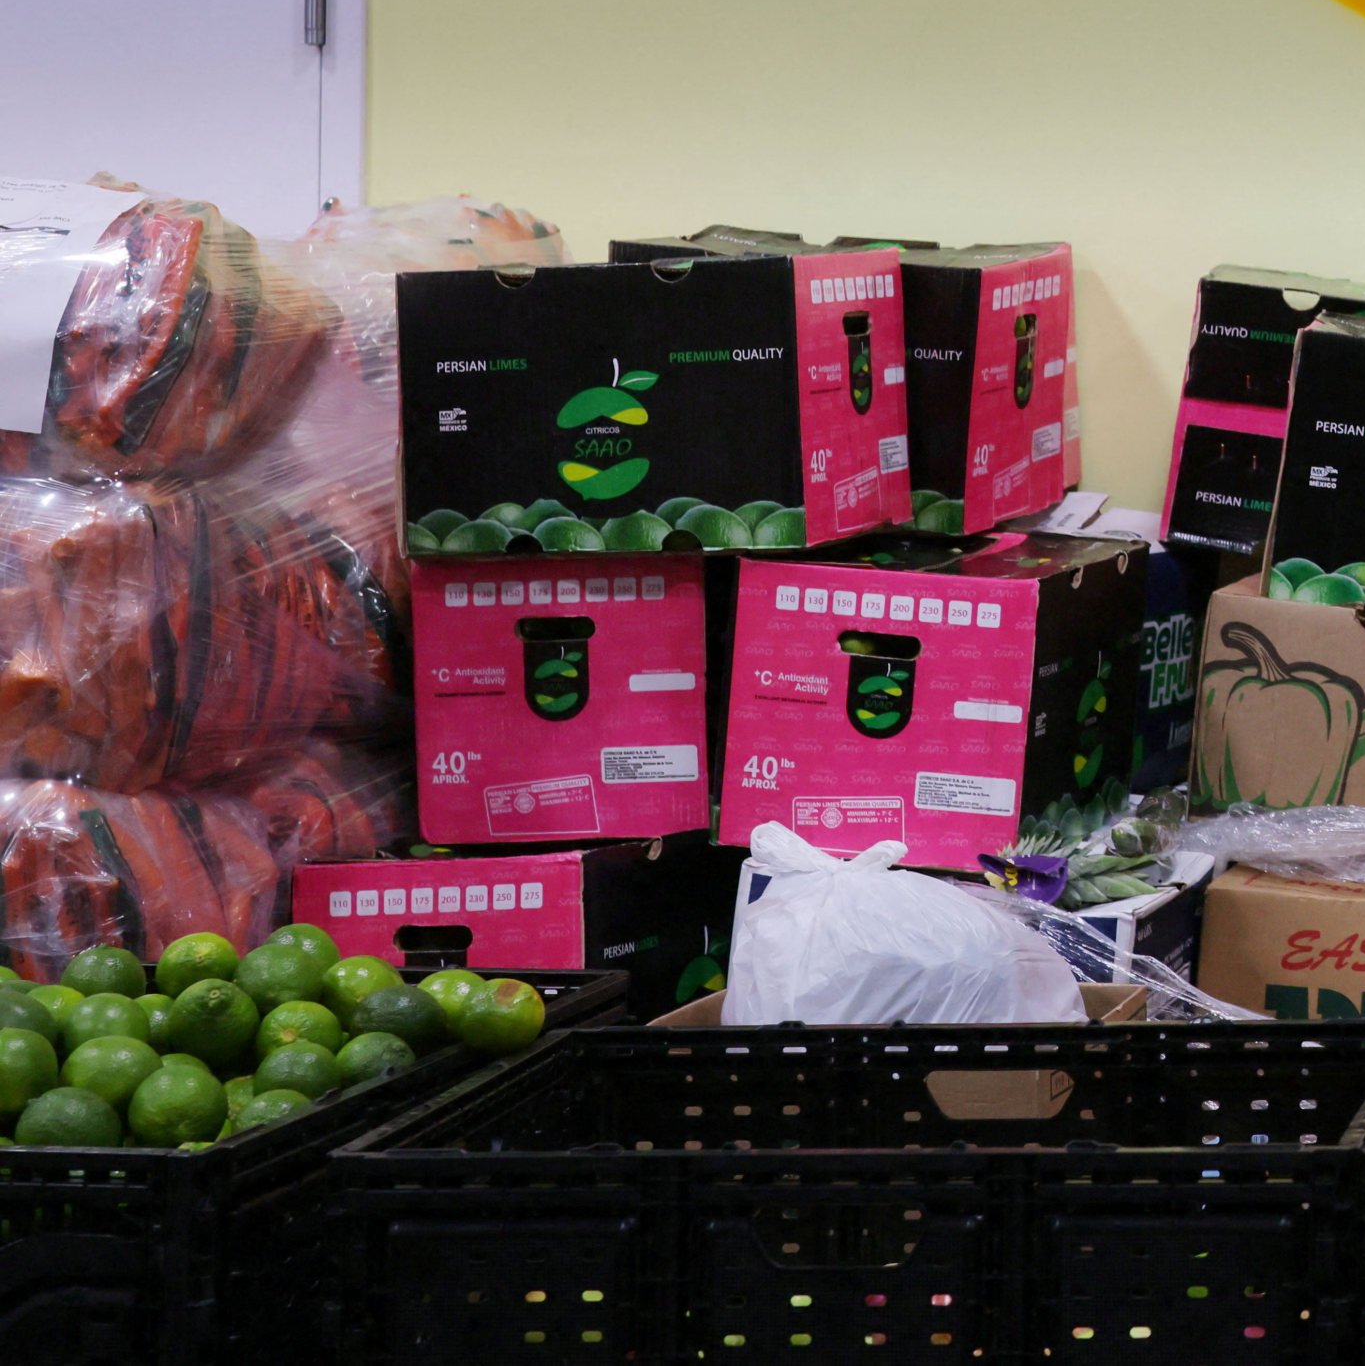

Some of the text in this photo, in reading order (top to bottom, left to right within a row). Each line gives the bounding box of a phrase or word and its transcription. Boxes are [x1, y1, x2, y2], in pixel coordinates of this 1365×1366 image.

[1201, 324, 1248, 339] QUALITY
[1250, 330, 1295, 345] REMIUM
[669, 347, 783, 363] PREMIUM QUALITY
[913, 347, 962, 361] QUALITY
[436, 358, 527, 373] PERSIAN LIMES
[585, 427, 620, 435] CITRICOS
[1315, 420, 1365, 437] PERSIAN
[574, 438, 632, 458] SAAO
[972, 445, 988, 466] 40
[810, 449, 826, 472] 40
[1195, 490, 1273, 513] PERSIAN LIME
[780, 593, 997, 621] 110 130 150 175 200 230 250 275
[455, 667, 505, 677] Antioxidant
[778, 672, 829, 684] Antioxidant
[473, 676, 506, 686] Activity
[795, 683, 829, 696] Activity
[432, 751, 481, 774] 40 lbs
[743, 755, 795, 778] 40 lbs
[432, 774, 470, 785] APROX.
[742, 777, 780, 791] APROX.
[872, 800, 899, 808] QUALITY
[332, 891, 540, 909] 110 130 150 175 200 230 250 275
[603, 941, 635, 959] PERSIAN
